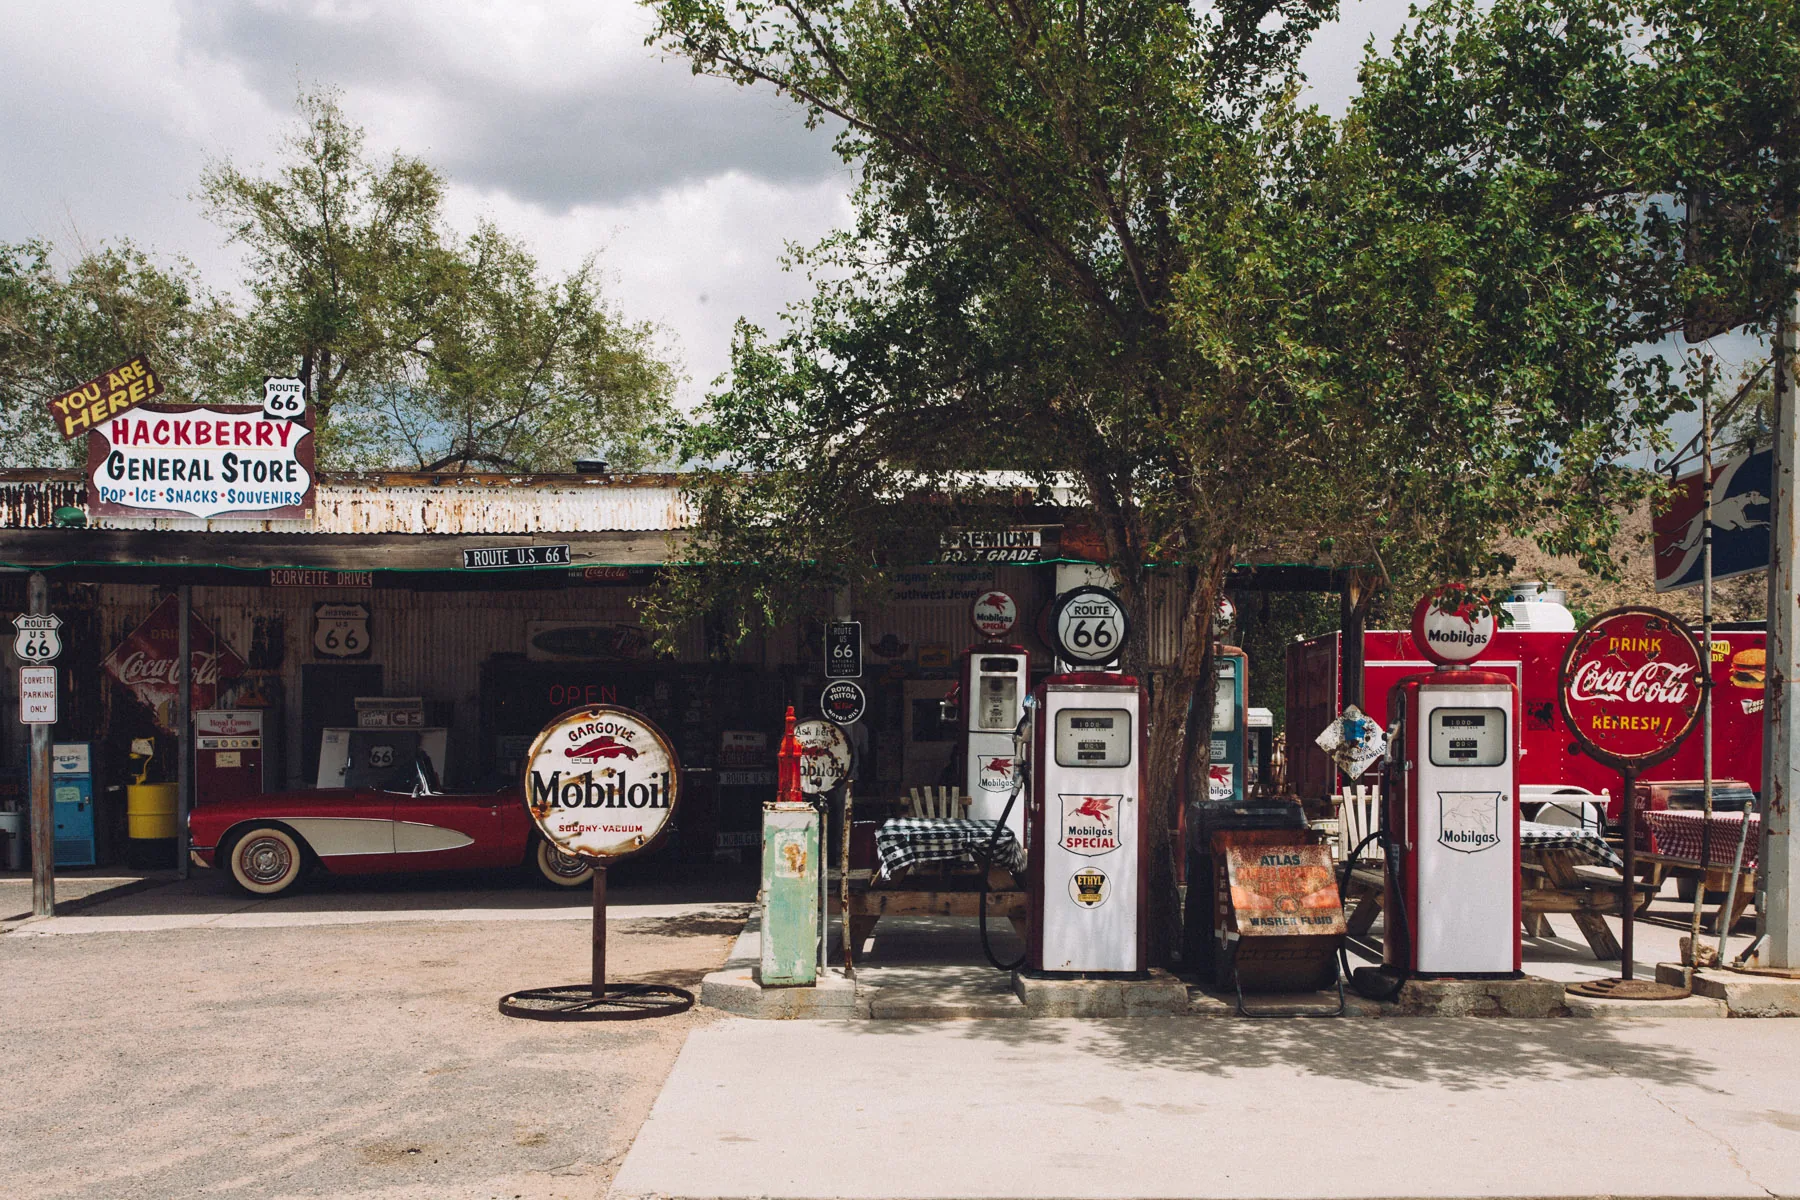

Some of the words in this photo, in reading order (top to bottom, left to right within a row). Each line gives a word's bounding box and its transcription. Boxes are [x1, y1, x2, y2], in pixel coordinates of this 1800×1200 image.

[55, 382, 100, 414] YOU
[108, 359, 147, 391] ARE
[269, 383, 300, 394] ROUTE
[64, 373, 156, 436] HERE!
[270, 395, 298, 411] 66
[112, 418, 293, 447] HACKBERRY
[107, 450, 214, 482] GENERAL
[222, 451, 297, 483] STORE
[100, 487, 126, 502] POP
[135, 487, 156, 502] ICE
[165, 488, 218, 503] SNACKS
[227, 488, 302, 505] SOUVENIRS
[474, 549, 509, 566] ROUTE
[517, 548, 539, 564] U.S.
[545, 546, 560, 562] 66
[986, 549, 1038, 561] GRADE
[275, 570, 329, 585] CORVETTE
[337, 570, 368, 585] DRIVE
[1074, 605, 1110, 616] ROUTE
[24, 620, 52, 628] ROUTE
[977, 613, 1013, 623] Mobilgas
[833, 627, 852, 635] ROUTE
[982, 622, 1006, 630] SPECIAL
[325, 629, 358, 649] 66
[1073, 620, 1112, 647] 66
[1428, 630, 1487, 646] Mobilgas
[26, 640, 50, 656] 66
[1609, 637, 1662, 652] DRINK
[834, 644, 853, 658] 66
[23, 676, 54, 685] CORVETTE
[1570, 660, 1696, 704] Coca-Cola
[23, 690, 54, 699] PARKING
[550, 684, 617, 705] OPEN
[831, 686, 855, 694] ROYAL
[829, 692, 857, 701] TRITON
[30, 705, 47, 713] ONLY
[848, 708, 859, 719] OILS
[210, 720, 228, 728] Royal
[387, 711, 420, 725] ICE
[796, 726, 811, 737] Ask
[1592, 715, 1673, 737] REFRESH!
[569, 722, 636, 743] GARGOYLE
[371, 750, 392, 763] 66
[1366, 742, 1387, 760] ANGELES
[726, 773, 749, 783] ROUTE
[982, 778, 1014, 789] Mobilgas
[530, 770, 670, 810] Mobiloil
[1210, 787, 1232, 796] bilgas
[1069, 826, 1113, 838] Mobilgas
[1443, 829, 1495, 846] Mobilgas
[1066, 838, 1115, 848] SPECIAL
[1260, 855, 1301, 866] ATLAS
[1077, 876, 1103, 886] ETHYL
[1249, 917, 1297, 926] WASHER
[1300, 916, 1333, 925] FLUID
